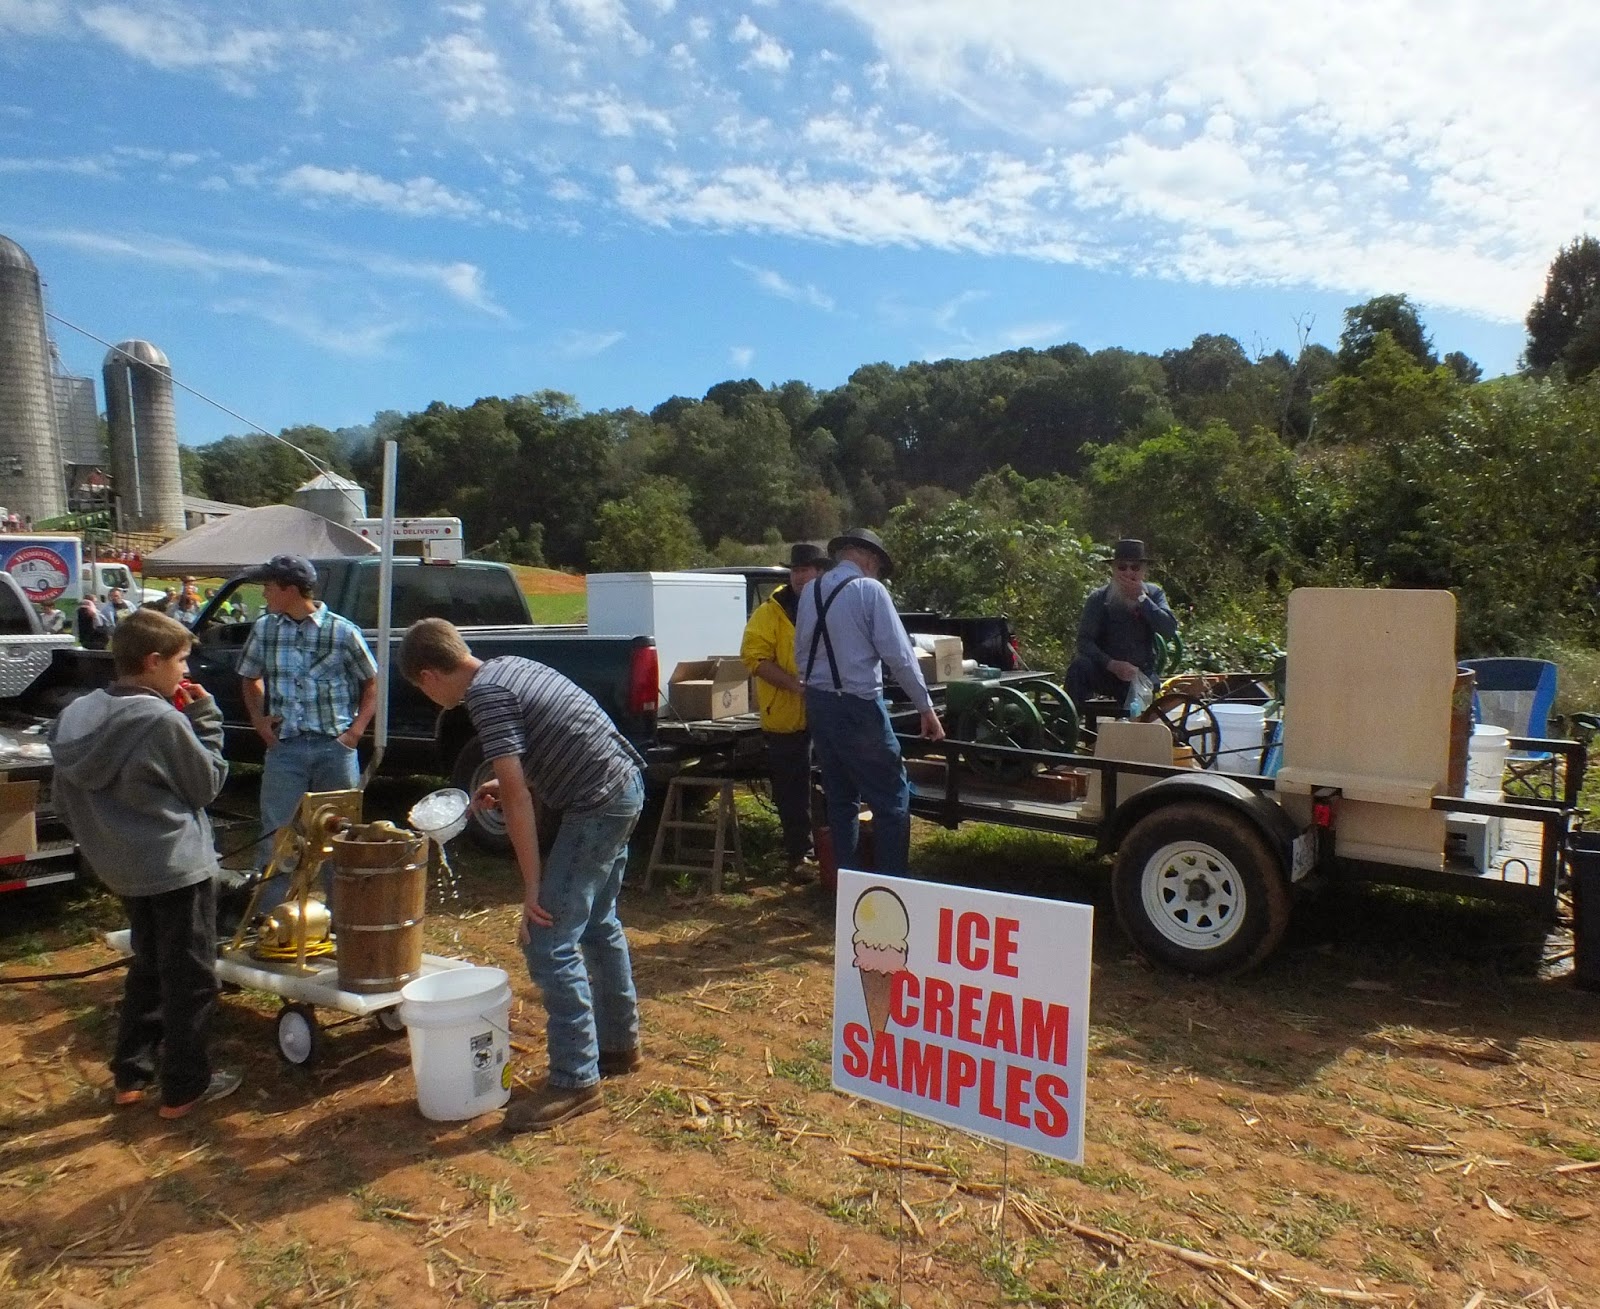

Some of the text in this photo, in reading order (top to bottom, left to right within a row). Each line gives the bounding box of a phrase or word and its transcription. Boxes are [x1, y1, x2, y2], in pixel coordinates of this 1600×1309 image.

[937, 907, 1020, 979] ICE
[889, 970, 1070, 1067] CREAM
[842, 1022, 1069, 1138] SAMPLES
